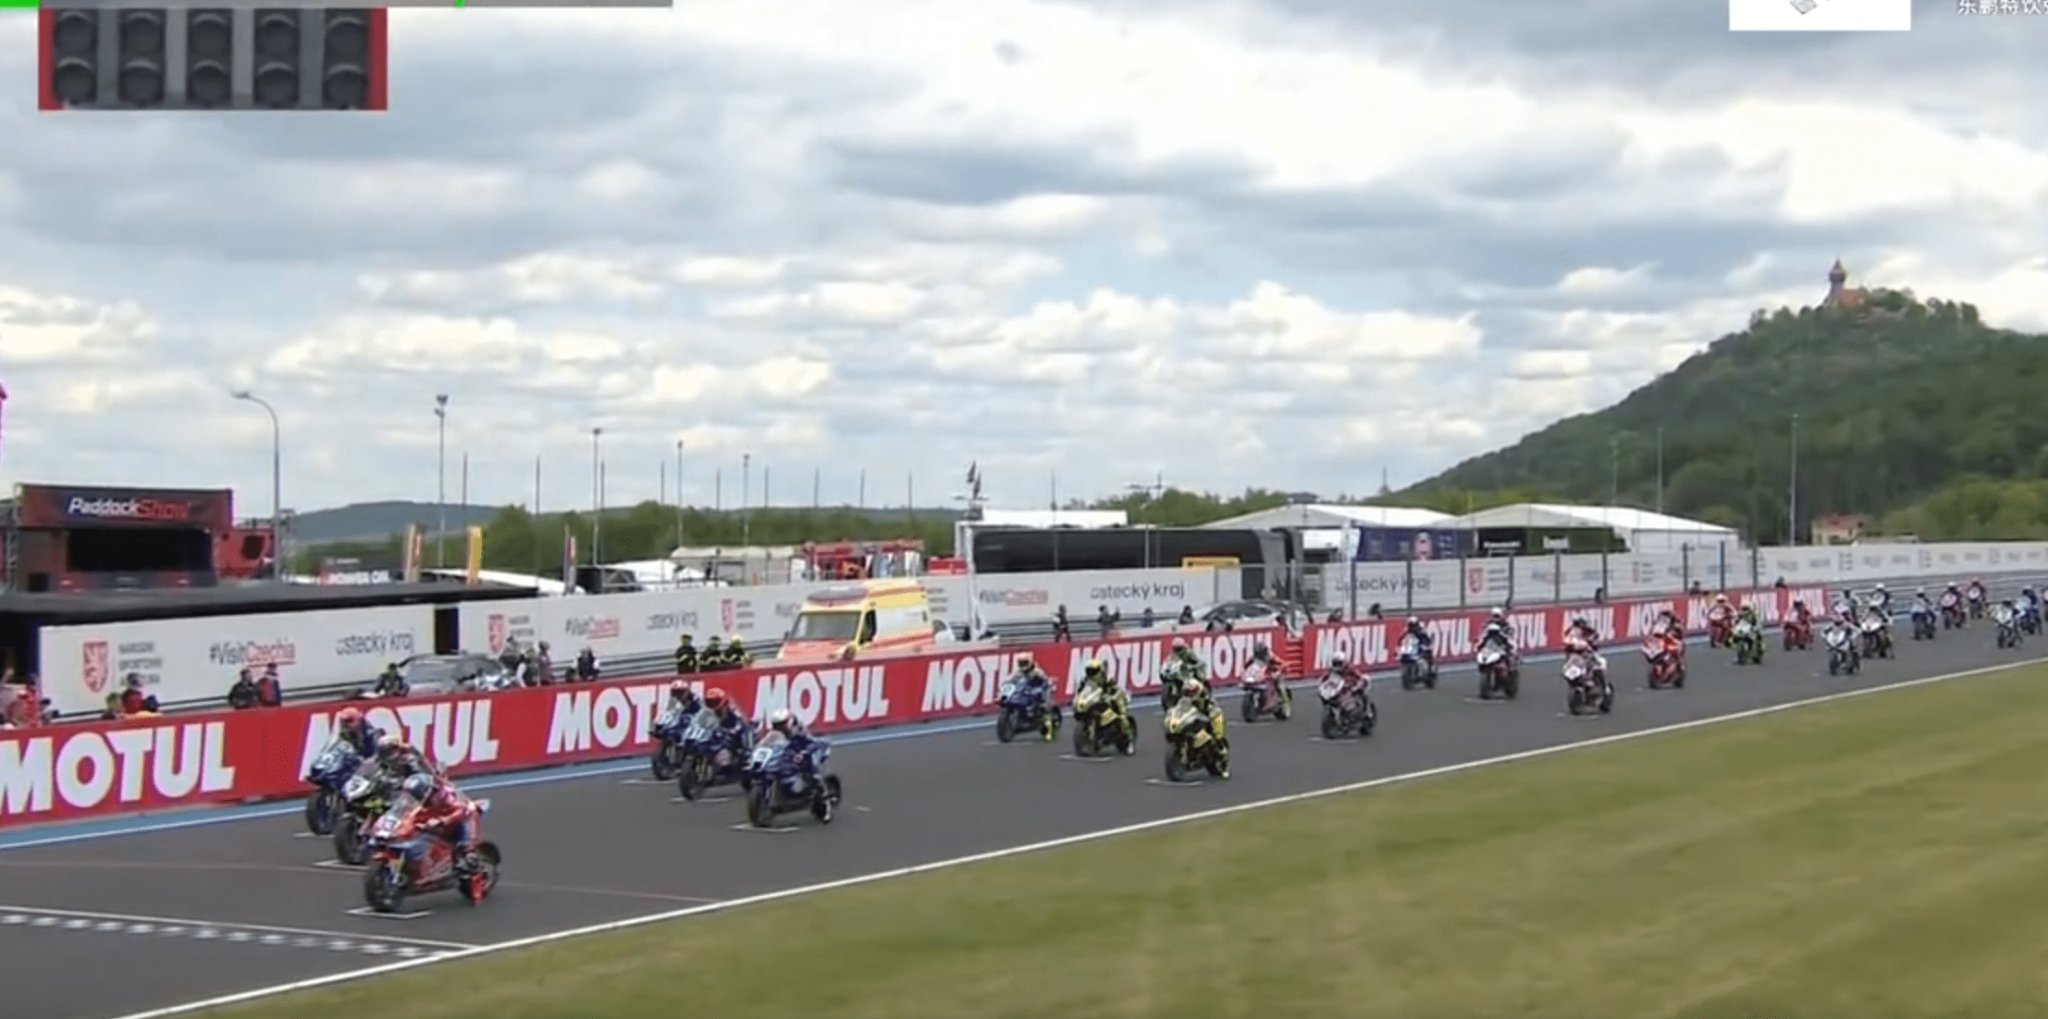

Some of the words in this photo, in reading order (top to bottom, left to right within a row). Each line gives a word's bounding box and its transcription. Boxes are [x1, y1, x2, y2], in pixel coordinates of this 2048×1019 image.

[1154, 581, 1185, 599] kraj
[1314, 624, 1388, 669] MOTUL
[1402, 618, 1471, 658] OTUL
[1065, 640, 1162, 695] MOTUL
[752, 665, 890, 731] MOTUL
[0, 721, 235, 815] MOTUL
